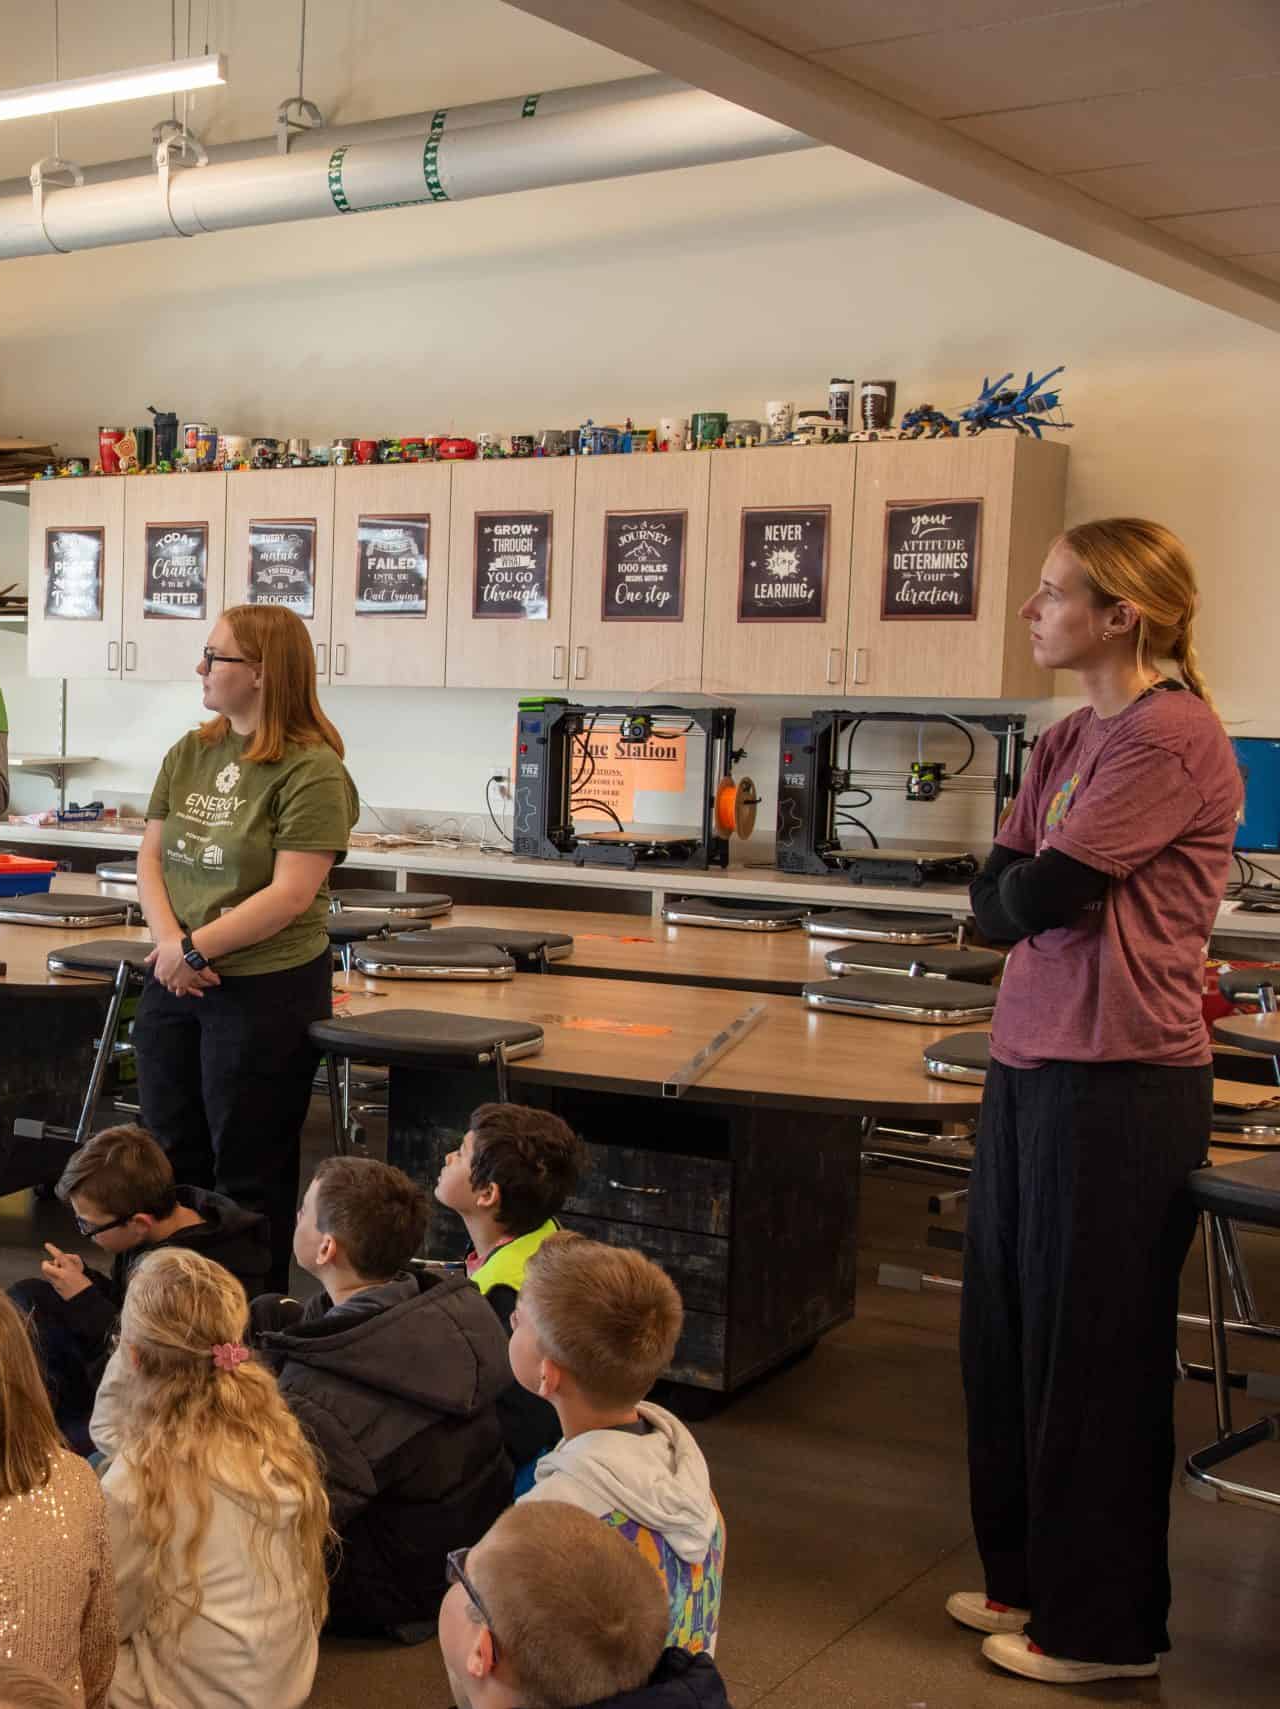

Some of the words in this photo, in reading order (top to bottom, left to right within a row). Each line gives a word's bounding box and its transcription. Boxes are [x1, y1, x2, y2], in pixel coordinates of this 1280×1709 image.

[494, 525, 532, 535] GROW
[911, 514, 952, 535] your
[617, 530, 672, 546] JOURNEY
[765, 525, 802, 541] NEVER
[492, 538, 533, 552] THROUGH
[900, 540, 965, 551] ATTITUDE
[152, 558, 201, 579] Chance
[367, 558, 416, 570] FAILED
[617, 564, 639, 573] 1000
[641, 564, 668, 573] MILES
[893, 552, 968, 570] DETERMINES
[487, 572, 512, 583] YOU
[515, 572, 533, 583] GO
[916, 571, 945, 581] Your
[152, 592, 198, 604] BETTER
[482, 584, 539, 605] through
[615, 583, 642, 604] One
[645, 585, 672, 608] step
[754, 583, 808, 599] LEARNING
[895, 580, 963, 605] direction
[256, 594, 304, 605] PROGRESS
[615, 742, 677, 758] Station
[185, 793, 247, 811] ENERGY
